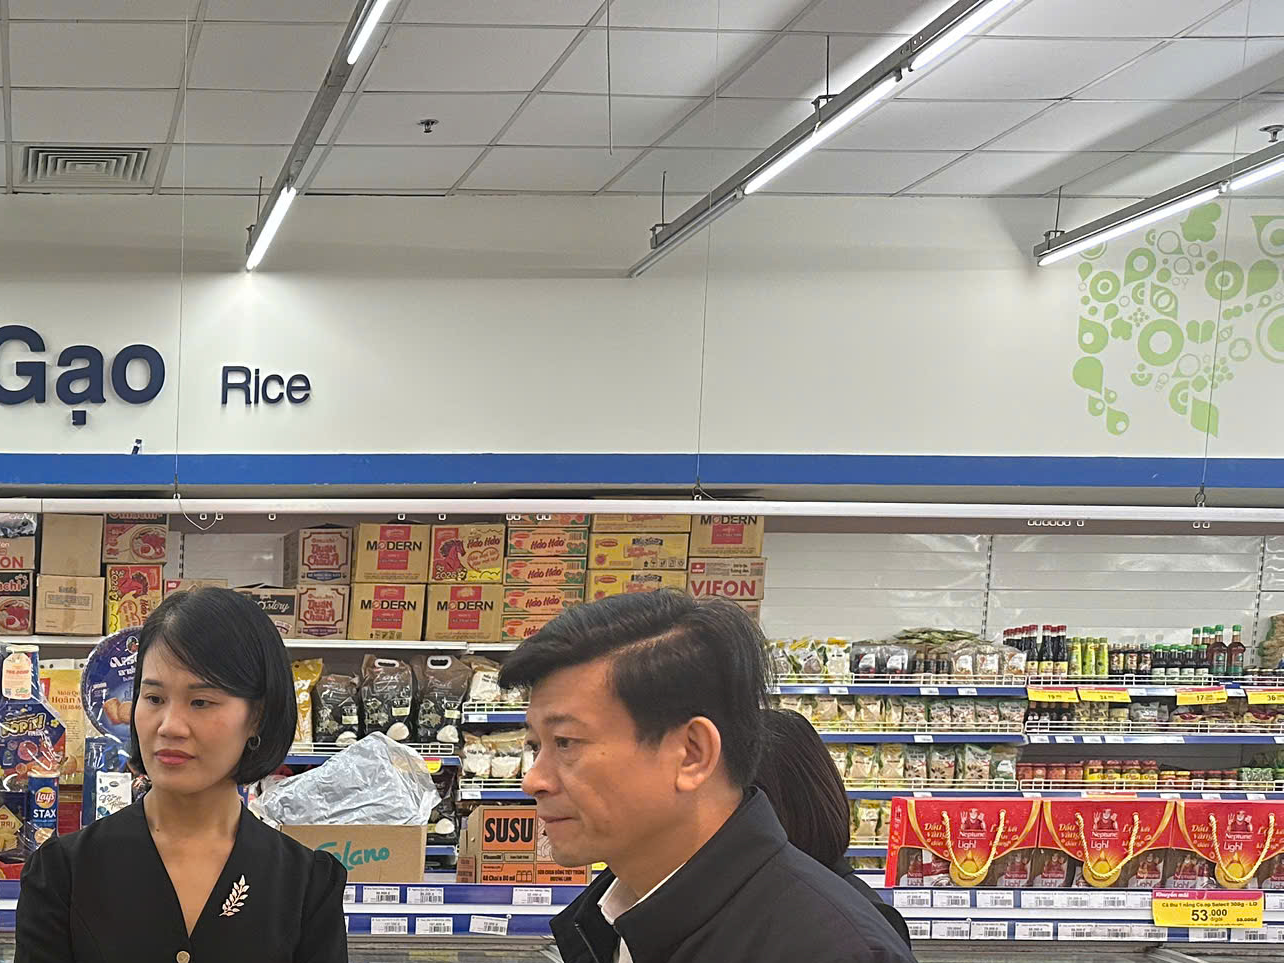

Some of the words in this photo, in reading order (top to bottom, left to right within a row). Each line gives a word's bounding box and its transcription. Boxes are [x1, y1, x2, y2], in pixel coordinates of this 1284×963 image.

[221, 365, 311, 405] Rice
[700, 515, 757, 525] MODERN
[366, 541, 422, 551] MODERN
[467, 537, 483, 549] Hảo
[484, 535, 500, 546] Hảo
[530, 540, 547, 550] Hảo
[548, 537, 564, 547] Hảo
[527, 568, 544, 579] Hảo
[545, 566, 562, 577] Hảo
[691, 580, 756, 597] VIFON
[361, 600, 416, 610] MODERN
[437, 601, 493, 611] MODERN
[525, 597, 542, 608] Hảo
[543, 595, 560, 605] Hảo
[33, 809, 56, 818] STAX
[484, 817, 534, 843] SUSU
[958, 839, 977, 850] Light
[1091, 840, 1109, 849] Light
[1224, 842, 1243, 852] Light
